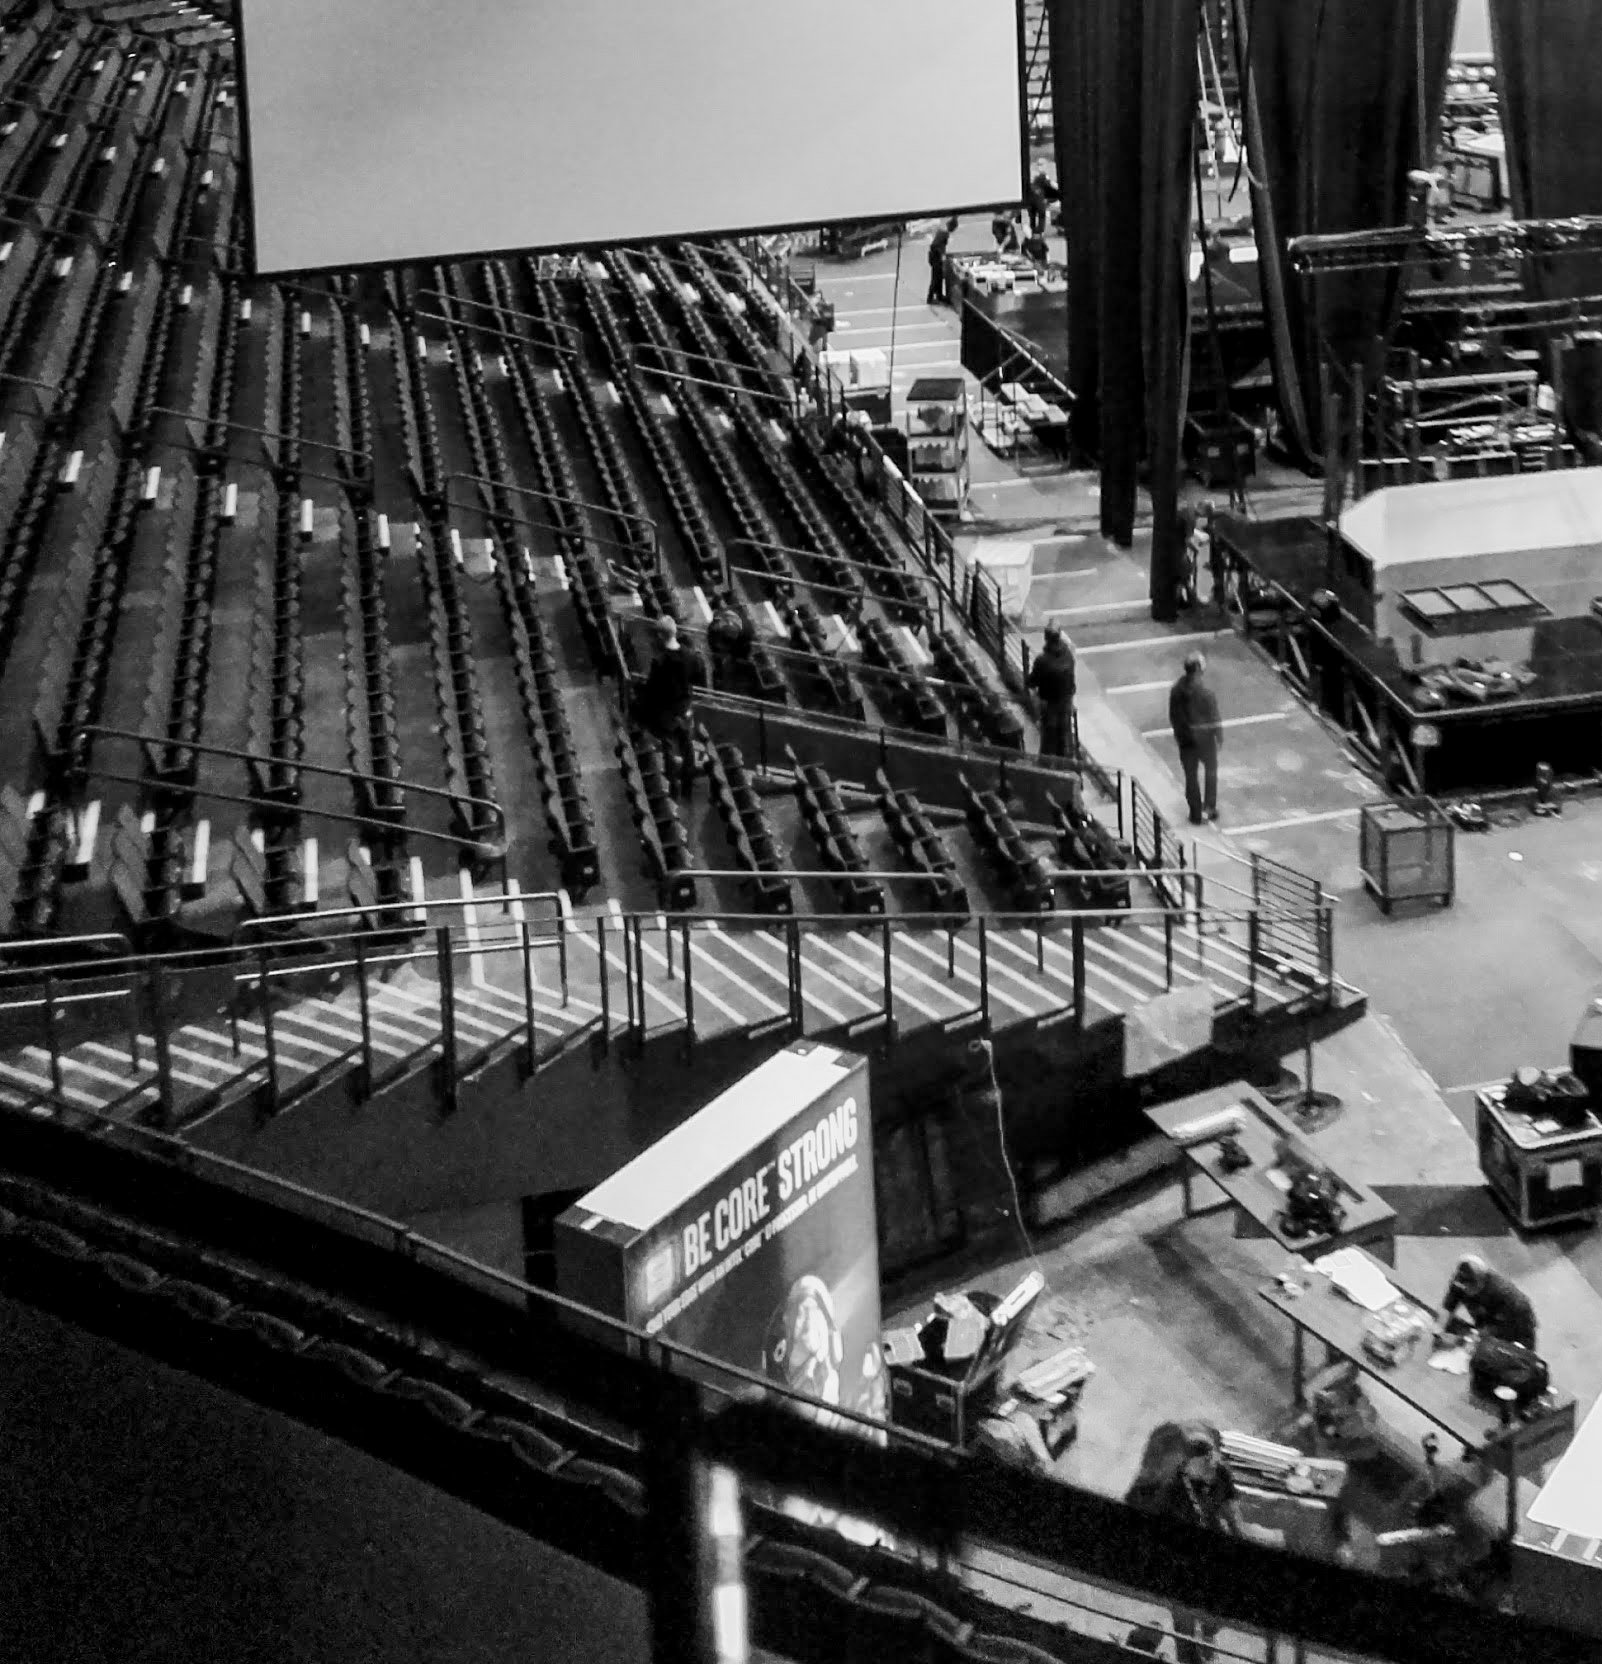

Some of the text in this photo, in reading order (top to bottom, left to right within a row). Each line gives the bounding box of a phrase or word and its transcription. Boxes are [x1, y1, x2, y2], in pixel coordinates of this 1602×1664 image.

[684, 1211, 713, 1277] BE
[714, 1166, 771, 1251] CORE
[777, 1096, 858, 1201] STRONG
